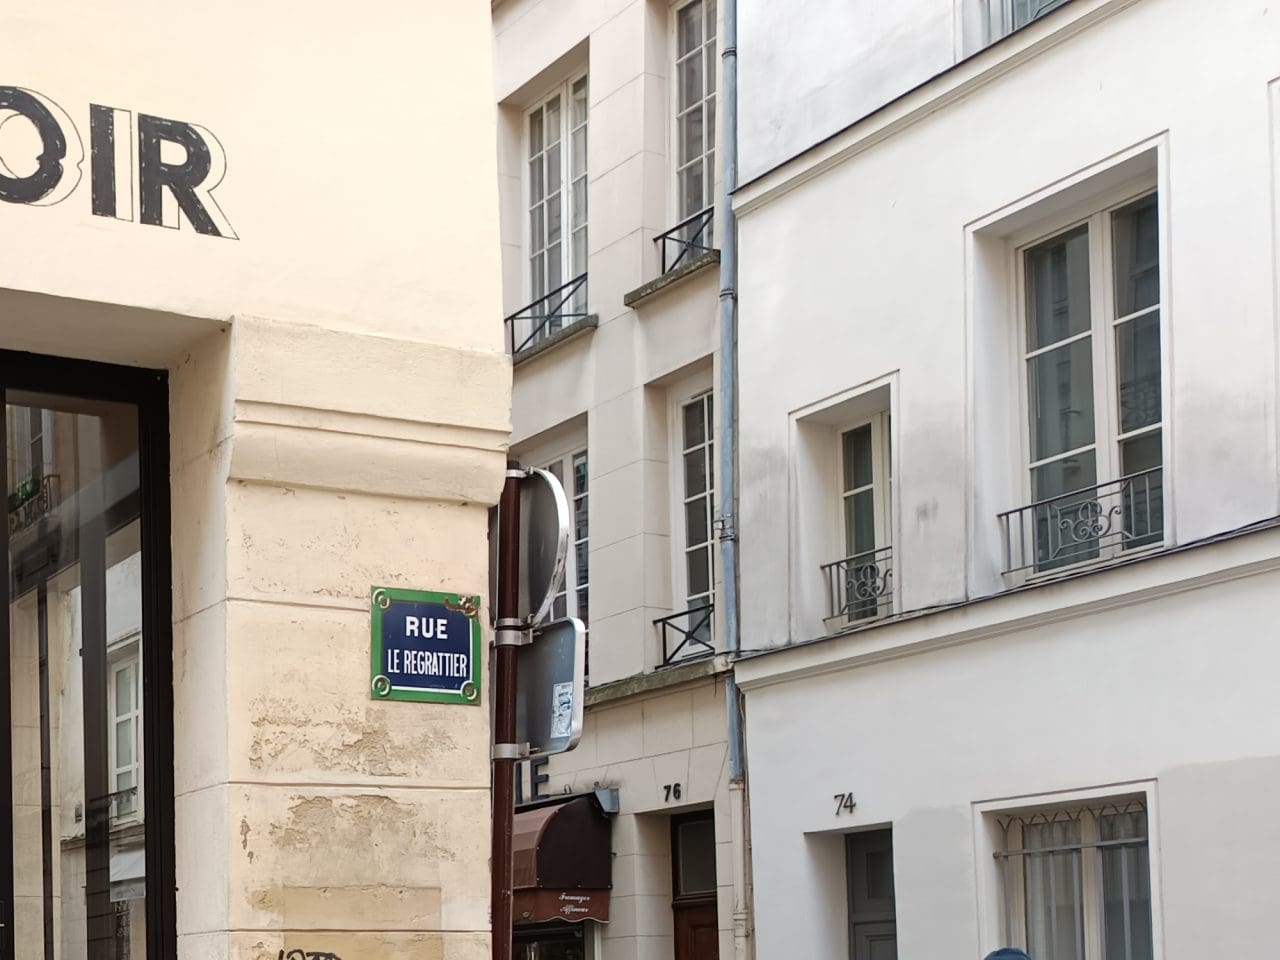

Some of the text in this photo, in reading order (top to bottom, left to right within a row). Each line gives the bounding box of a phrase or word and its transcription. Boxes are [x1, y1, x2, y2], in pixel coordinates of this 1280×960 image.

[405, 615, 448, 639] RUE
[387, 648, 467, 678] LE REGRATTIER
[663, 782, 682, 802] 76
[833, 792, 857, 816] 74
